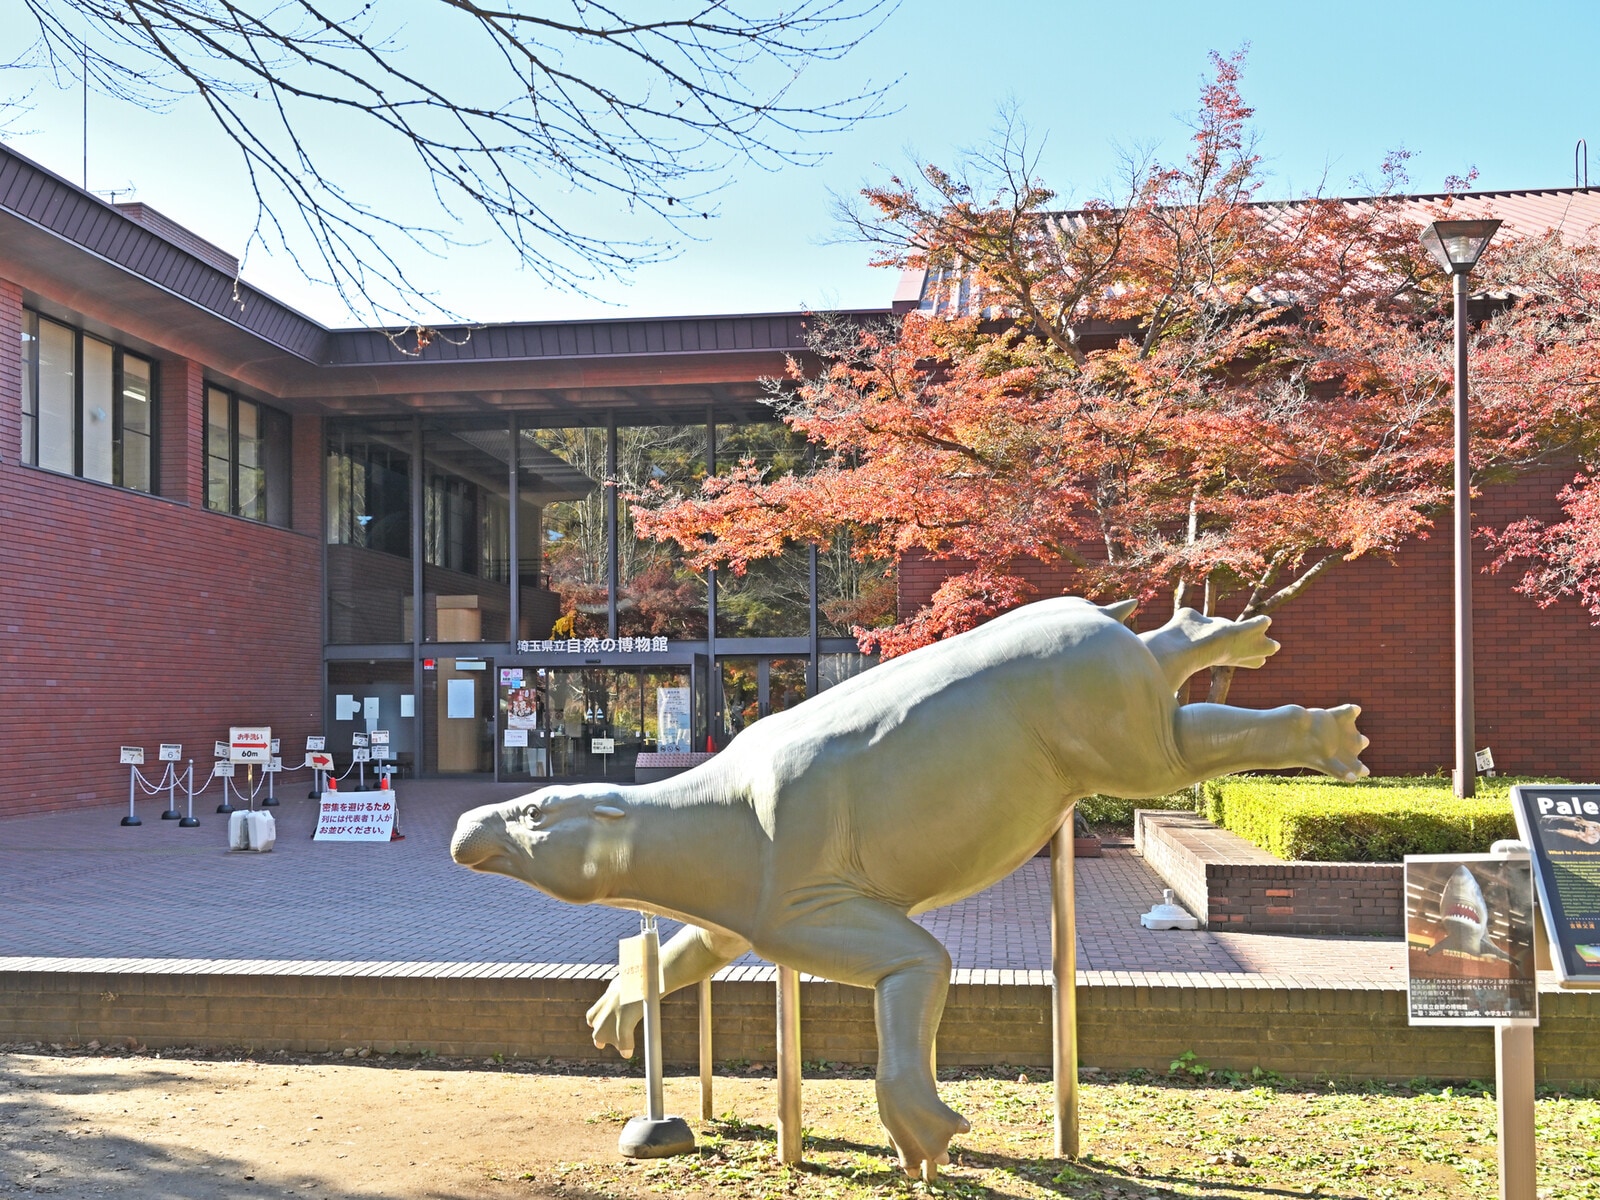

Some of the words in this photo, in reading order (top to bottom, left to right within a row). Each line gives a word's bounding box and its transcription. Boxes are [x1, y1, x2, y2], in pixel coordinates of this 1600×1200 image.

[516, 636, 668, 653] 埼玉県立自然の博物館
[237, 733, 263, 741] お手洗い
[241, 750, 259, 758] 60m
[322, 803, 391, 812] 密集を避けるため
[319, 826, 384, 834] お並びください。
